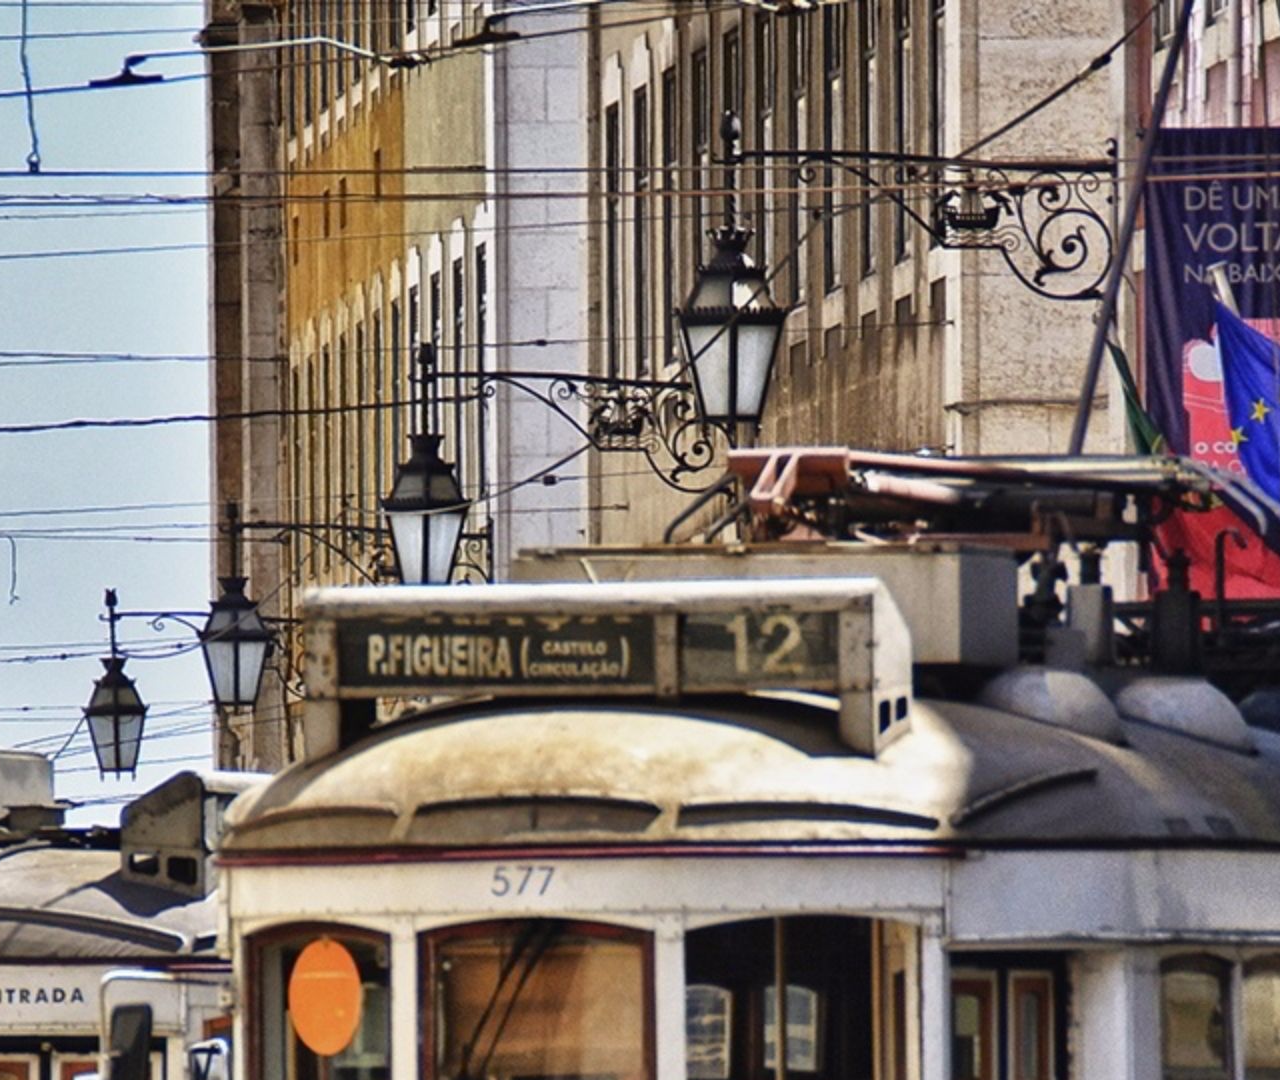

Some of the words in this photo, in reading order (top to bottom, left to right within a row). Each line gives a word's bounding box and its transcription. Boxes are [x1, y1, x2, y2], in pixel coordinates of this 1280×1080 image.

[1184, 180, 1223, 211] DÊ
[726, 613, 805, 674] 12
[491, 866, 555, 897] 577
